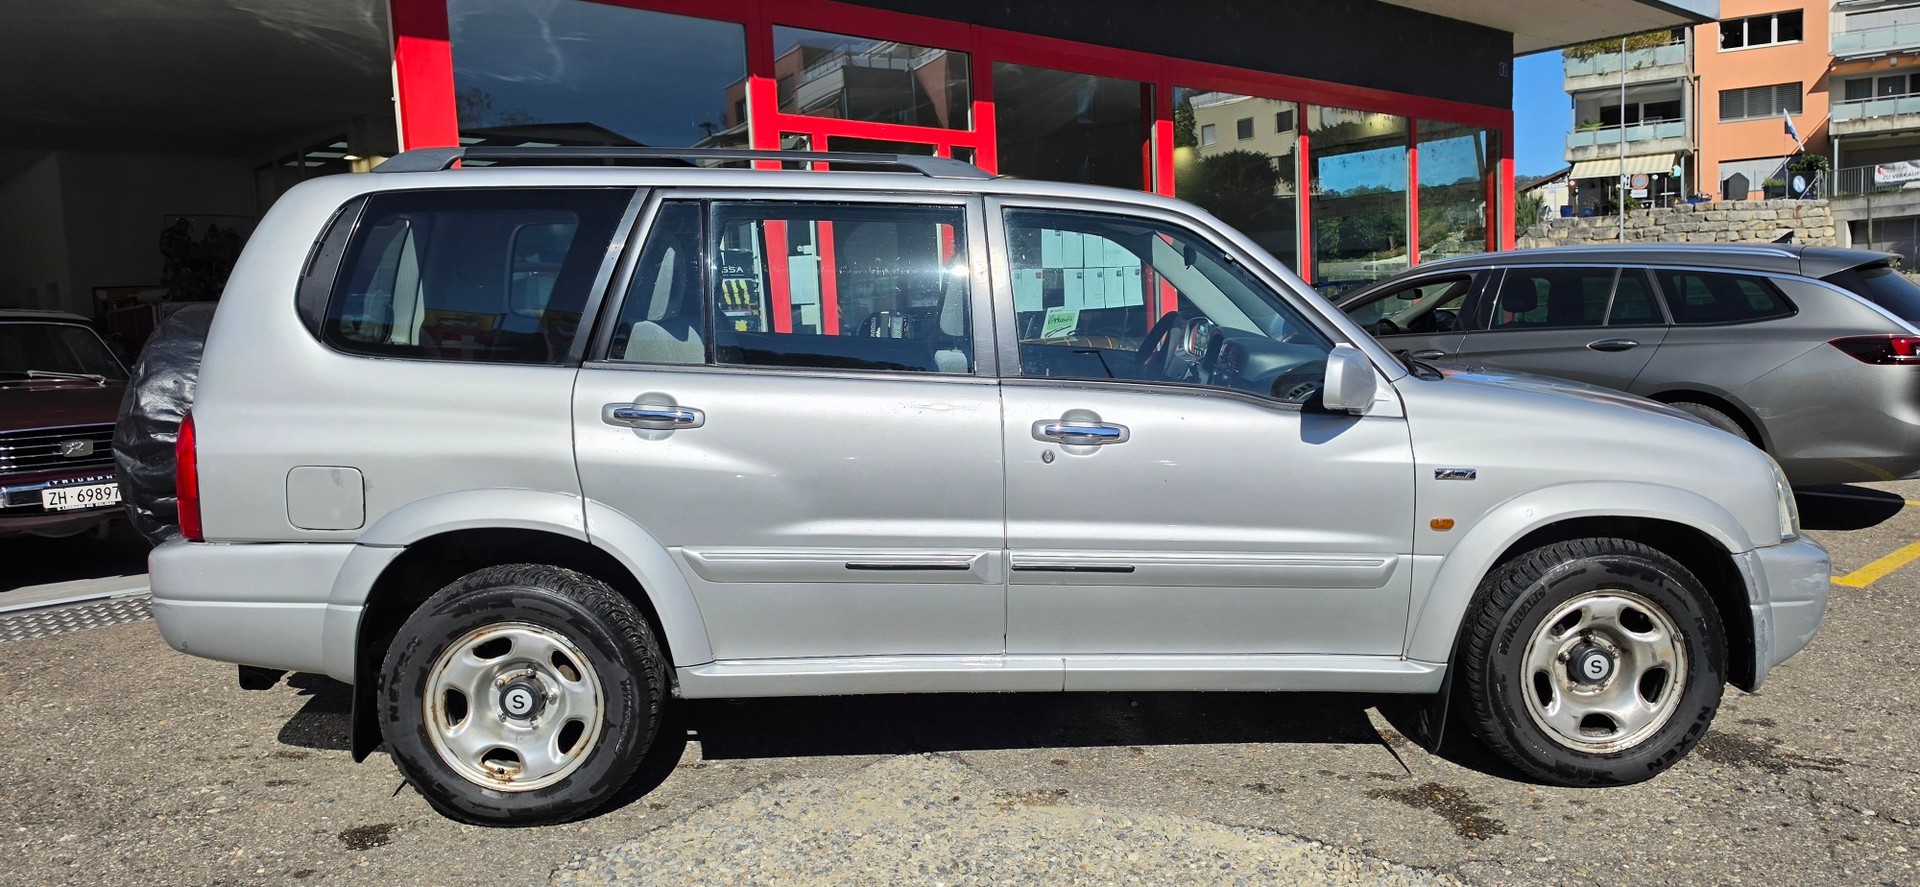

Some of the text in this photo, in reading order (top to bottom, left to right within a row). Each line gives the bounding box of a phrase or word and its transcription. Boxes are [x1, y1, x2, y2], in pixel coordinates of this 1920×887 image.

[52, 475, 113, 485] TRIUMPH
[1497, 586, 1545, 655] WINGUARD
[1591, 659, 1603, 674] S
[512, 694, 525, 709] S
[1646, 705, 1711, 772] NEXEN
